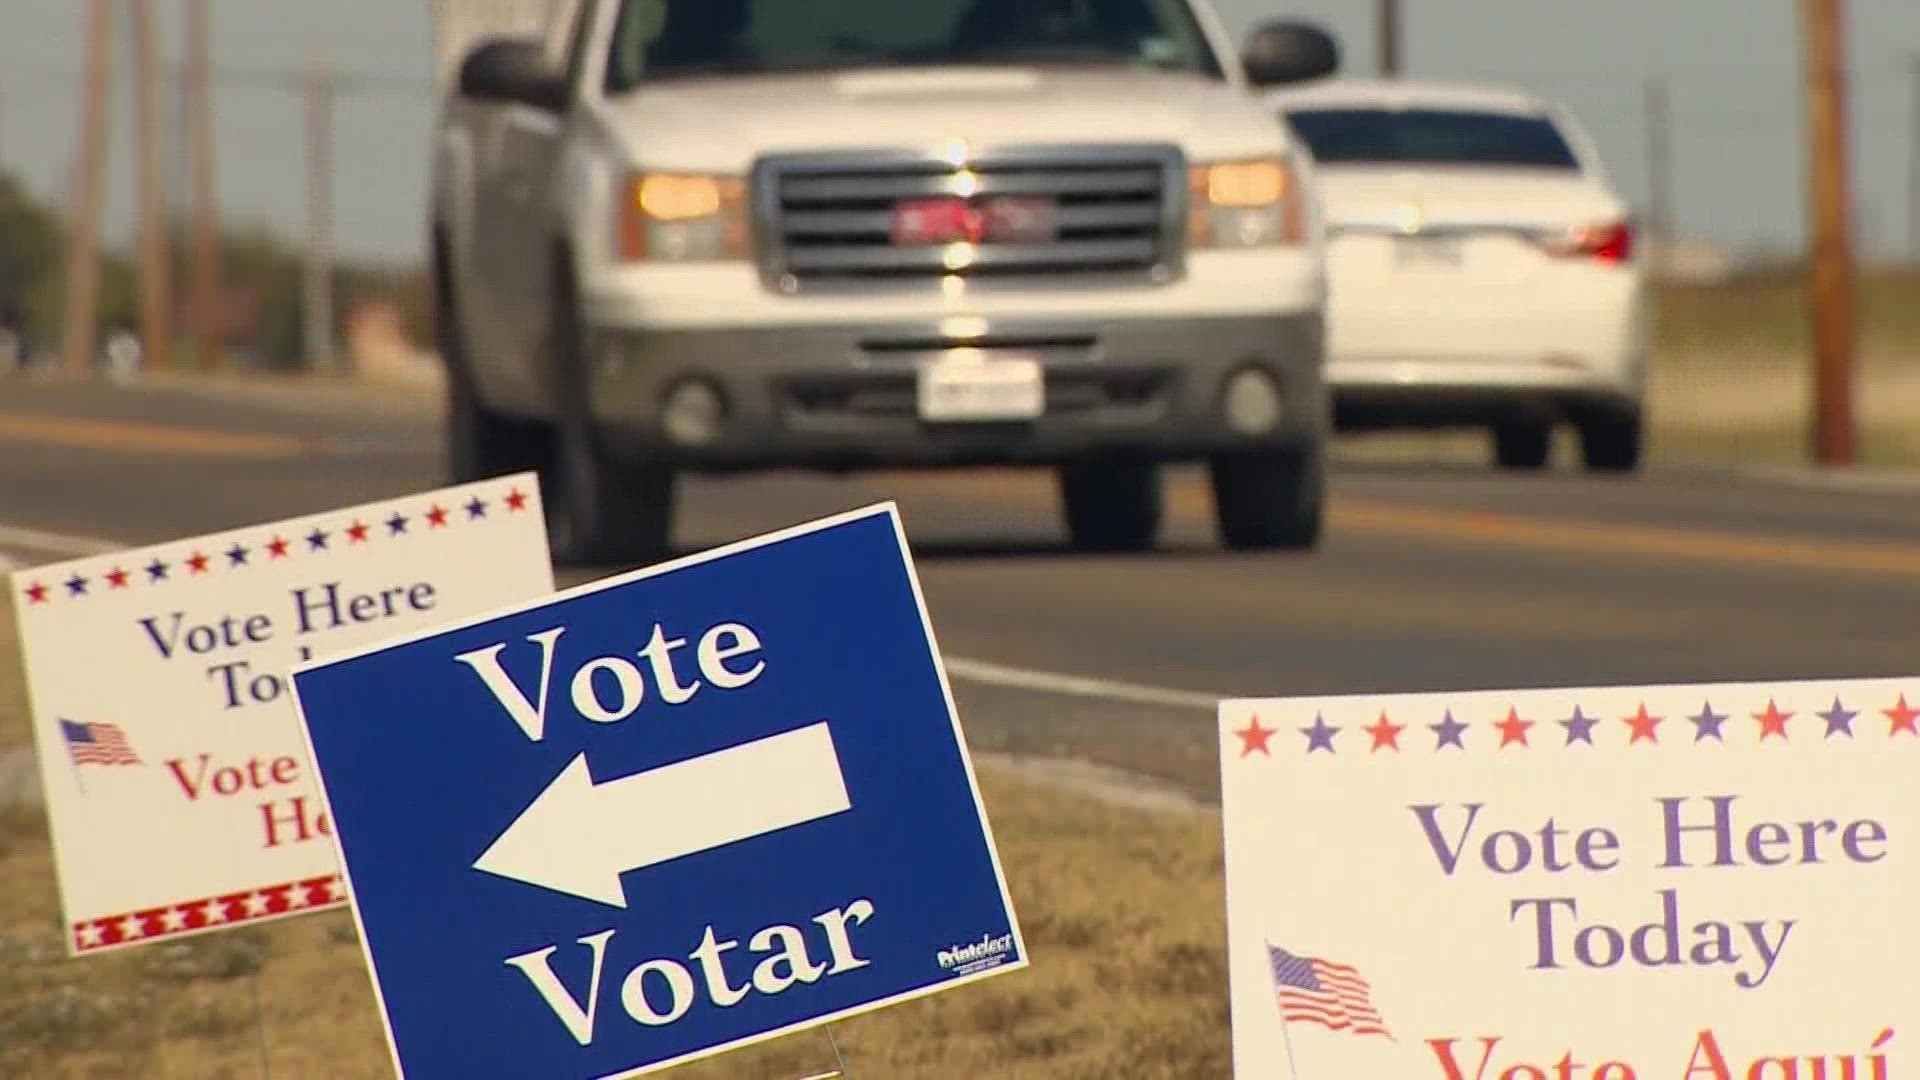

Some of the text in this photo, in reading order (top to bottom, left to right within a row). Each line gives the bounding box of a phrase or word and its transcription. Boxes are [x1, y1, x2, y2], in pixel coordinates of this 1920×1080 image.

[138, 582, 437, 660] Vote Here
[455, 619, 766, 742] Vote
[166, 753, 299, 802] Vote
[1408, 794, 1888, 877] Vote Here
[506, 896, 874, 1046] Votar
[1509, 889, 1796, 989] Today
[1680, 1028, 1896, 1080] Aí
